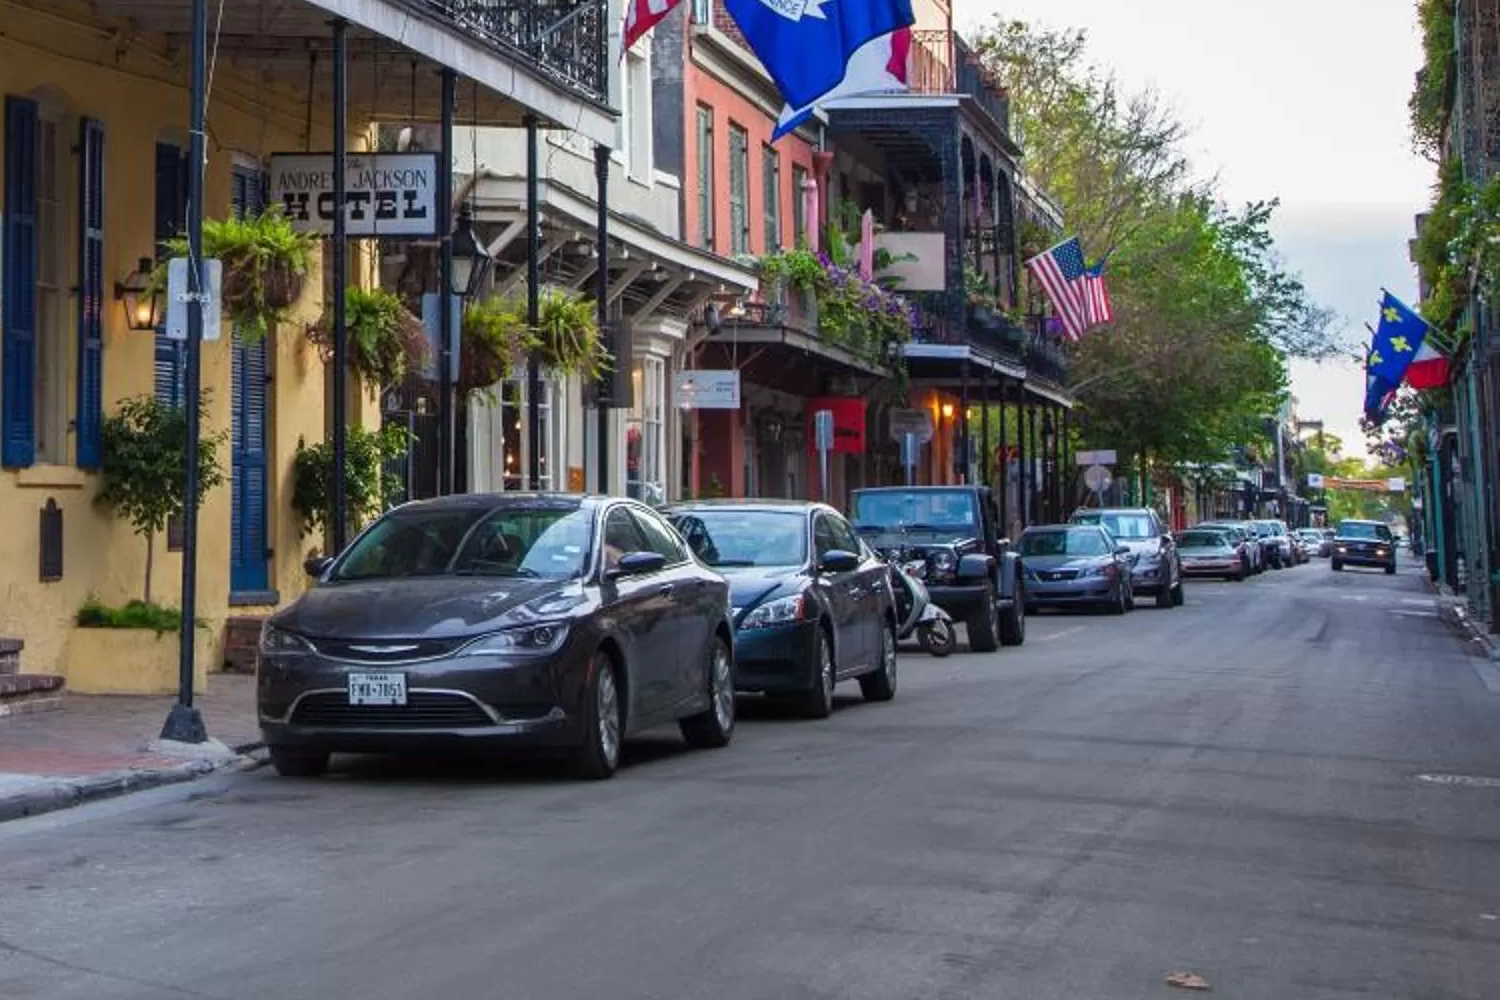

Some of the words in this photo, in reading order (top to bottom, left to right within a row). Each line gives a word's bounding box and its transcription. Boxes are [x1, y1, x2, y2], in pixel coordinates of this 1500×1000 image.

[279, 169, 336, 189] ANDRE
[353, 168, 427, 188] JACKSON
[283, 190, 427, 220] HOTEL
